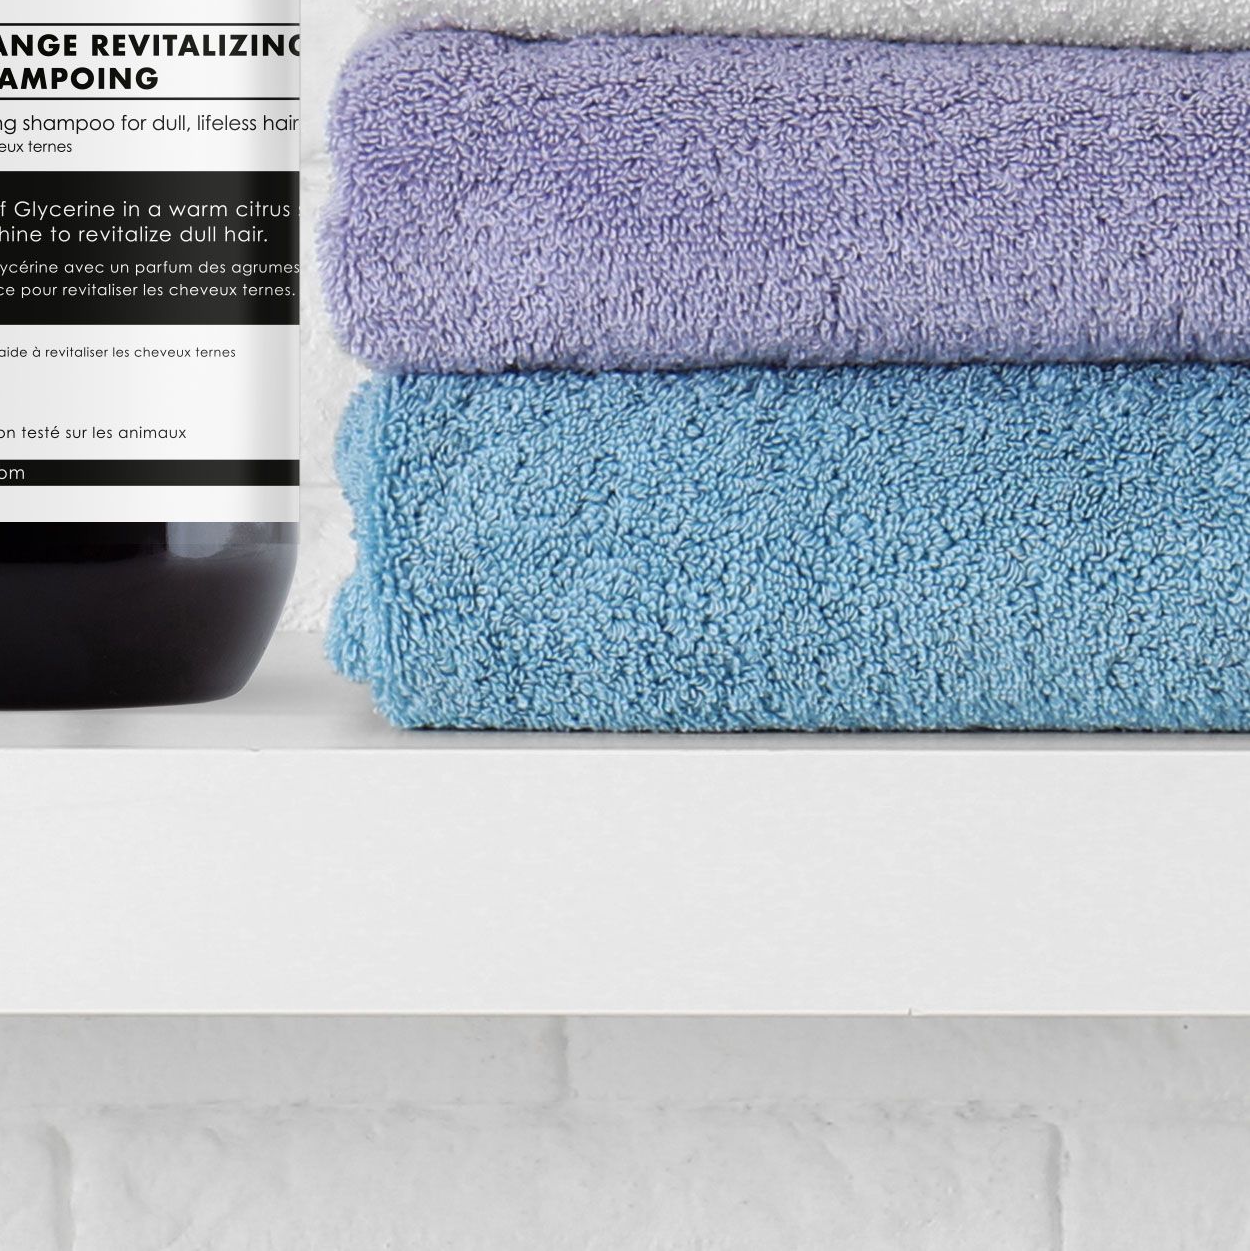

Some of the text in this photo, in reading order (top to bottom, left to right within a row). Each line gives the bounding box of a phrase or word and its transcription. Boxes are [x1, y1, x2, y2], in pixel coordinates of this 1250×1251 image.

[22, 114, 116, 135] shampoo
[120, 114, 148, 132] for
[152, 114, 191, 133] dull,
[197, 114, 257, 132] lifeless
[263, 114, 300, 132] hair
[27, 140, 73, 153] ternes
[13, 200, 116, 221] Glycerine
[123, 200, 140, 217] in
[148, 204, 161, 218] a
[168, 204, 228, 218] warm
[235, 200, 291, 218] citrus
[50, 225, 71, 243] to
[78, 225, 172, 243] revitalize
[179, 225, 216, 243] dull
[224, 225, 268, 243] hair.
[63, 263, 105, 274] avec
[110, 263, 130, 274] un
[135, 260, 193, 277] parfum
[198, 260, 226, 274] des
[231, 263, 300, 277] agrumes
[21, 286, 58, 299] pour
[62, 283, 139, 297] revitaliser
[143, 283, 164, 297] les
[168, 283, 238, 297] cheveux
[242, 283, 296, 297] ternes.
[32, 345, 41, 358] à
[45, 346, 109, 358] revitaliser
[112, 346, 130, 358] les
[133, 346, 191, 358] cheveux
[195, 346, 236, 358] ternes
[21, 425, 60, 439] testé
[65, 428, 88, 439] sur
[92, 426, 113, 439] les
[118, 425, 187, 439] animaux
